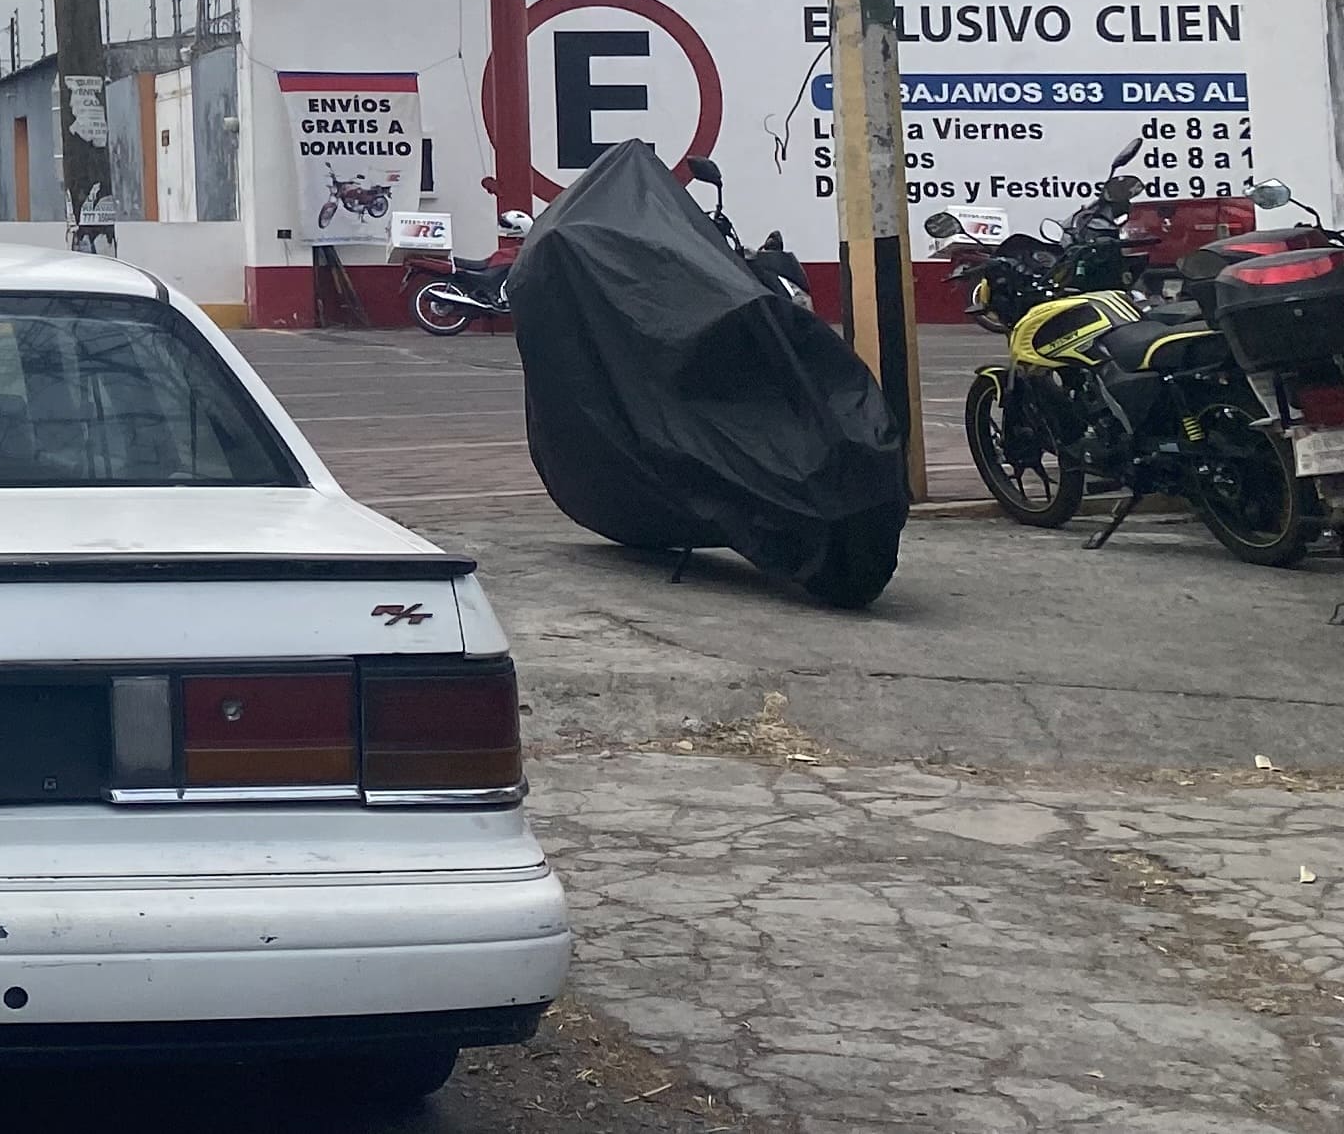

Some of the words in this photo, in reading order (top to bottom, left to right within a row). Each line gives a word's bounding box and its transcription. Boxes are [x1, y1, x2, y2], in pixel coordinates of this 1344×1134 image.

[804, 5, 1071, 42] ELUSIVO
[1096, 4, 1244, 42] CLIEN
[554, 31, 652, 168] E
[825, 81, 1043, 104] BAJAMOS
[1052, 82, 1104, 103] 363
[1121, 82, 1195, 103] DIAS
[1203, 82, 1246, 102] AL
[308, 95, 391, 113] ENVÍOS
[302, 119, 379, 134] GRATIS
[388, 120, 404, 134] A
[907, 123, 923, 139] a
[932, 117, 1044, 140] Viernes
[1142, 118, 1177, 140] de
[1186, 118, 1202, 140] 8
[1213, 123, 1229, 140] a
[300, 141, 412, 156] DOMICILIO
[1144, 147, 1178, 169] de
[1188, 147, 1203, 169] 8
[1214, 153, 1230, 169] a
[964, 183, 981, 203] y
[990, 176, 1103, 198] Festivos
[1145, 177, 1179, 198] de
[1189, 176, 1205, 198] 9
[1215, 182, 1231, 197] a
[411, 226, 445, 237] RC
[971, 223, 1002, 235] RC
